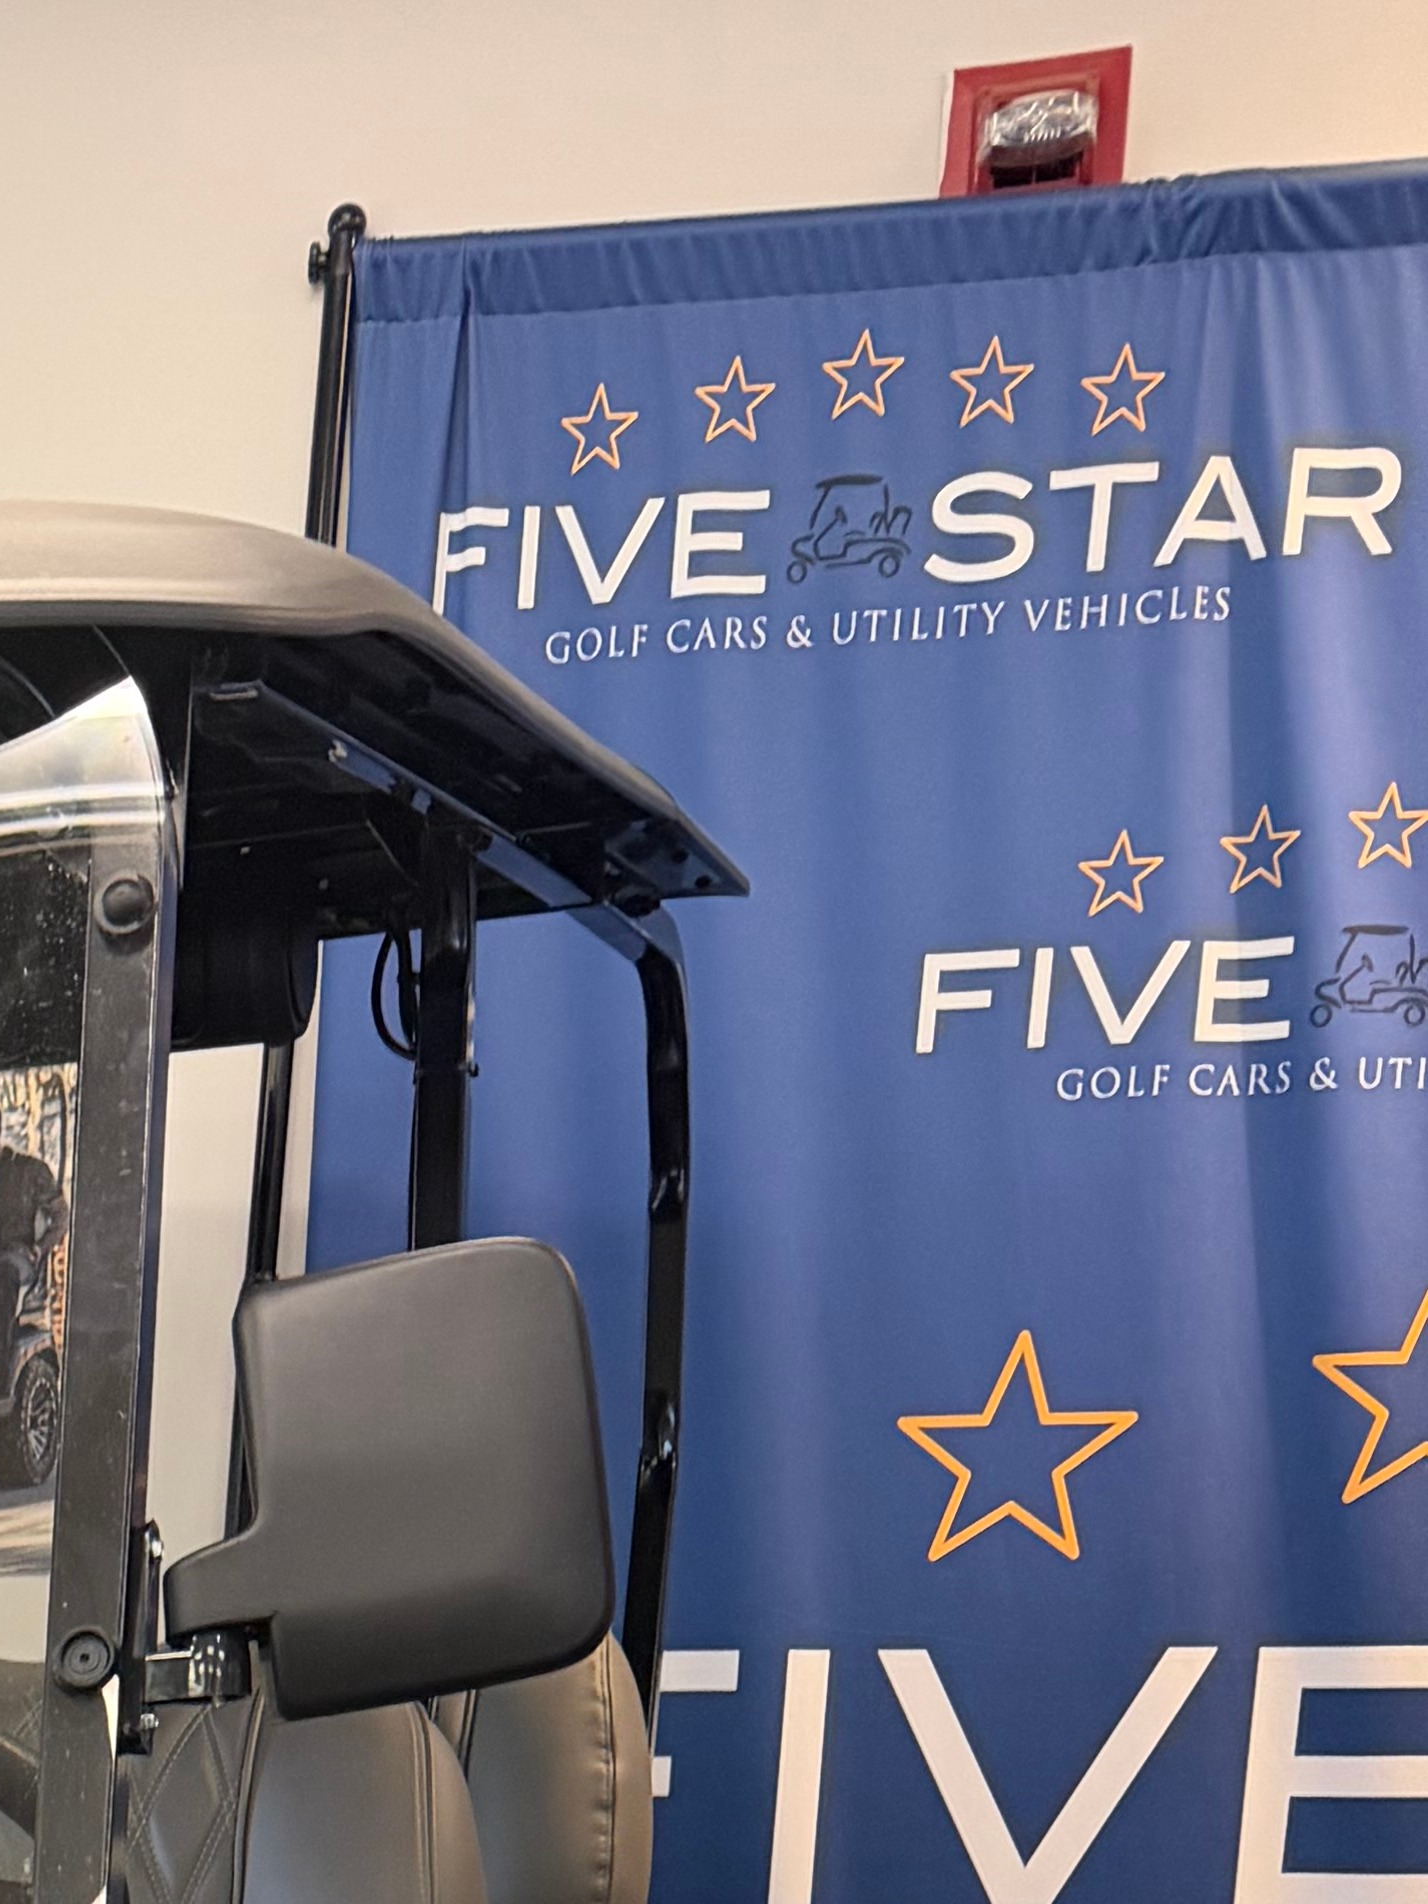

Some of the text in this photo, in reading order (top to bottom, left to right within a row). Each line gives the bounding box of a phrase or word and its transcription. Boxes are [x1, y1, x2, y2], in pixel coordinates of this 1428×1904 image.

[432, 446, 1404, 615] FIVE STAR
[545, 586, 1232, 665] GOLF CARS & UTILITY VEHICLES
[917, 937, 1295, 1054] FIVE
[1056, 1064, 1170, 1101] GOLF
[1188, 1060, 1291, 1096] CARS
[1309, 1056, 1338, 1091] &
